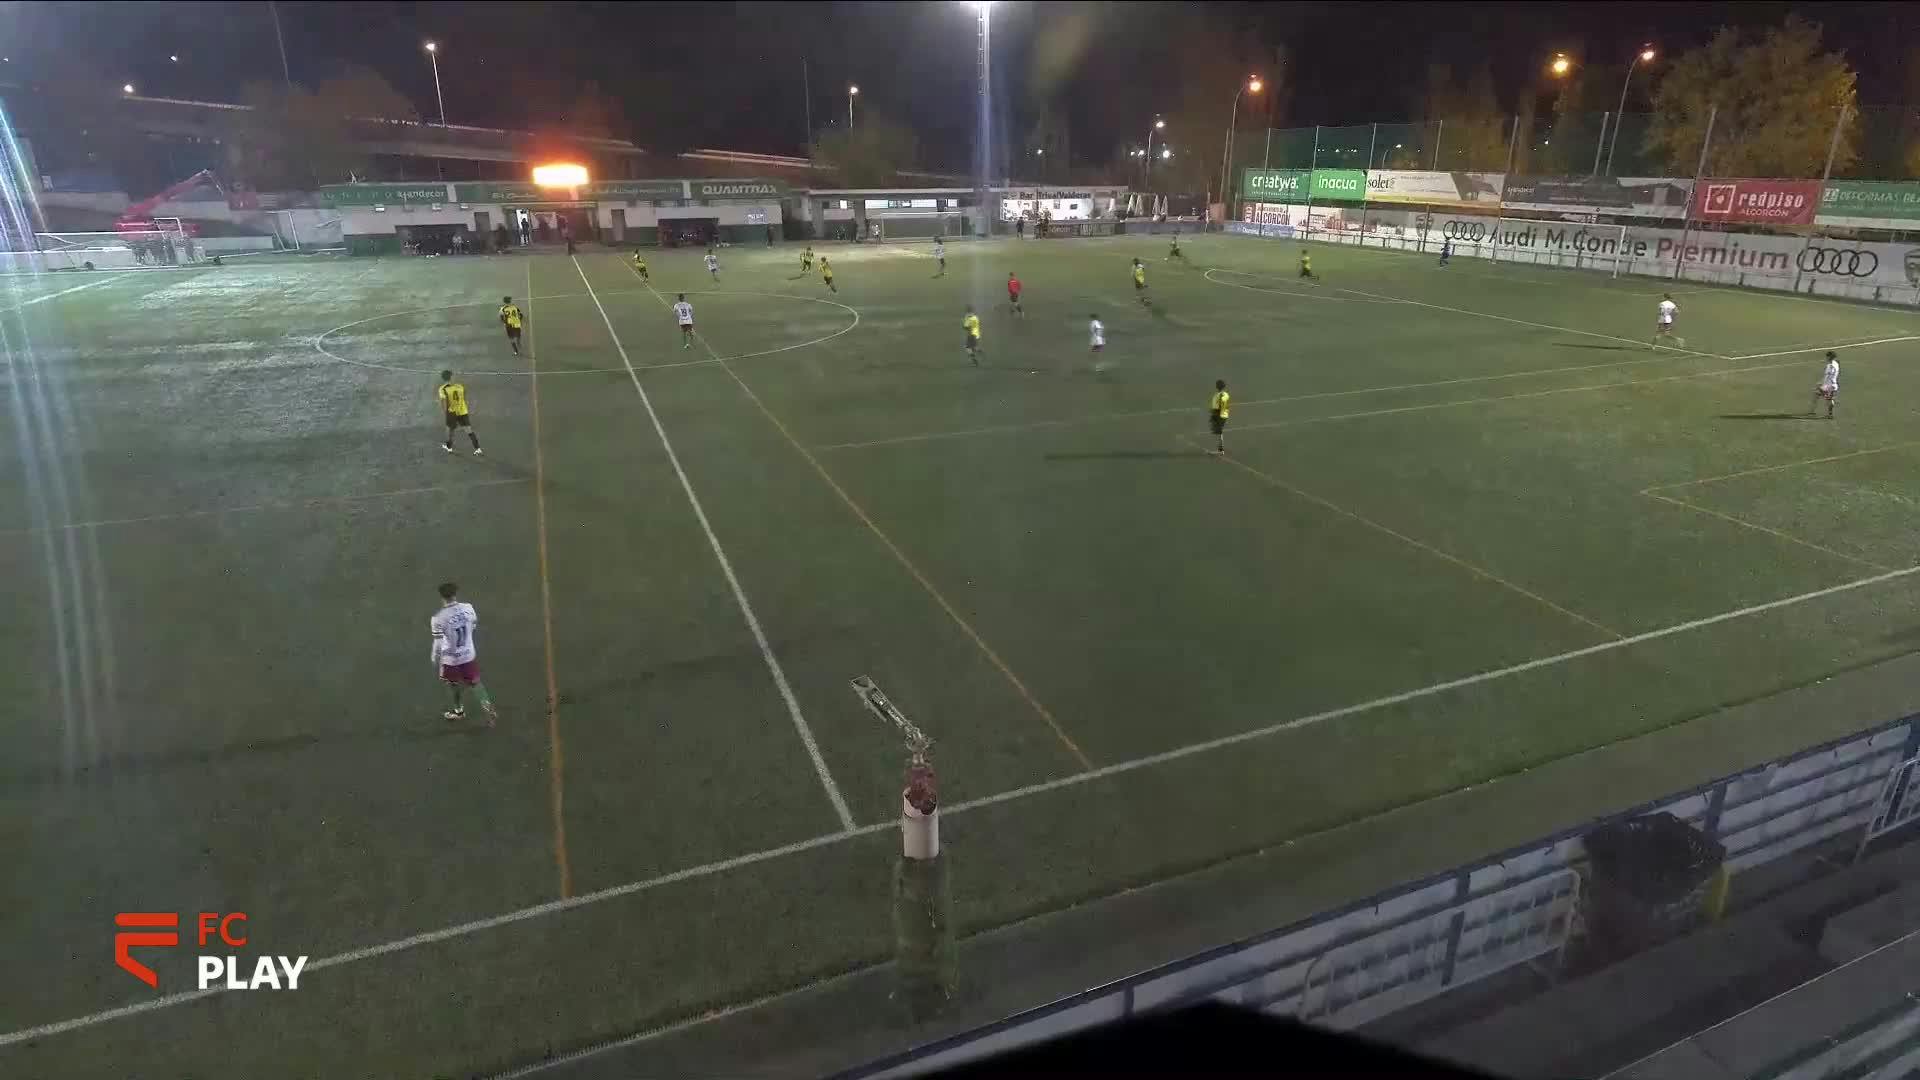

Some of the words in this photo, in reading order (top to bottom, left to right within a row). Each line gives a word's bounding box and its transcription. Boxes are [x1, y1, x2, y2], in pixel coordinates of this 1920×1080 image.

[702, 184, 777, 195] QUAMTRAX
[1318, 174, 1357, 190] inacua
[1019, 192, 1034, 200] Bar
[1738, 191, 1804, 209] redpiso
[1489, 226, 1538, 248] Audi
[1545, 228, 1647, 257] M.Conde
[1655, 238, 1789, 269] Premium
